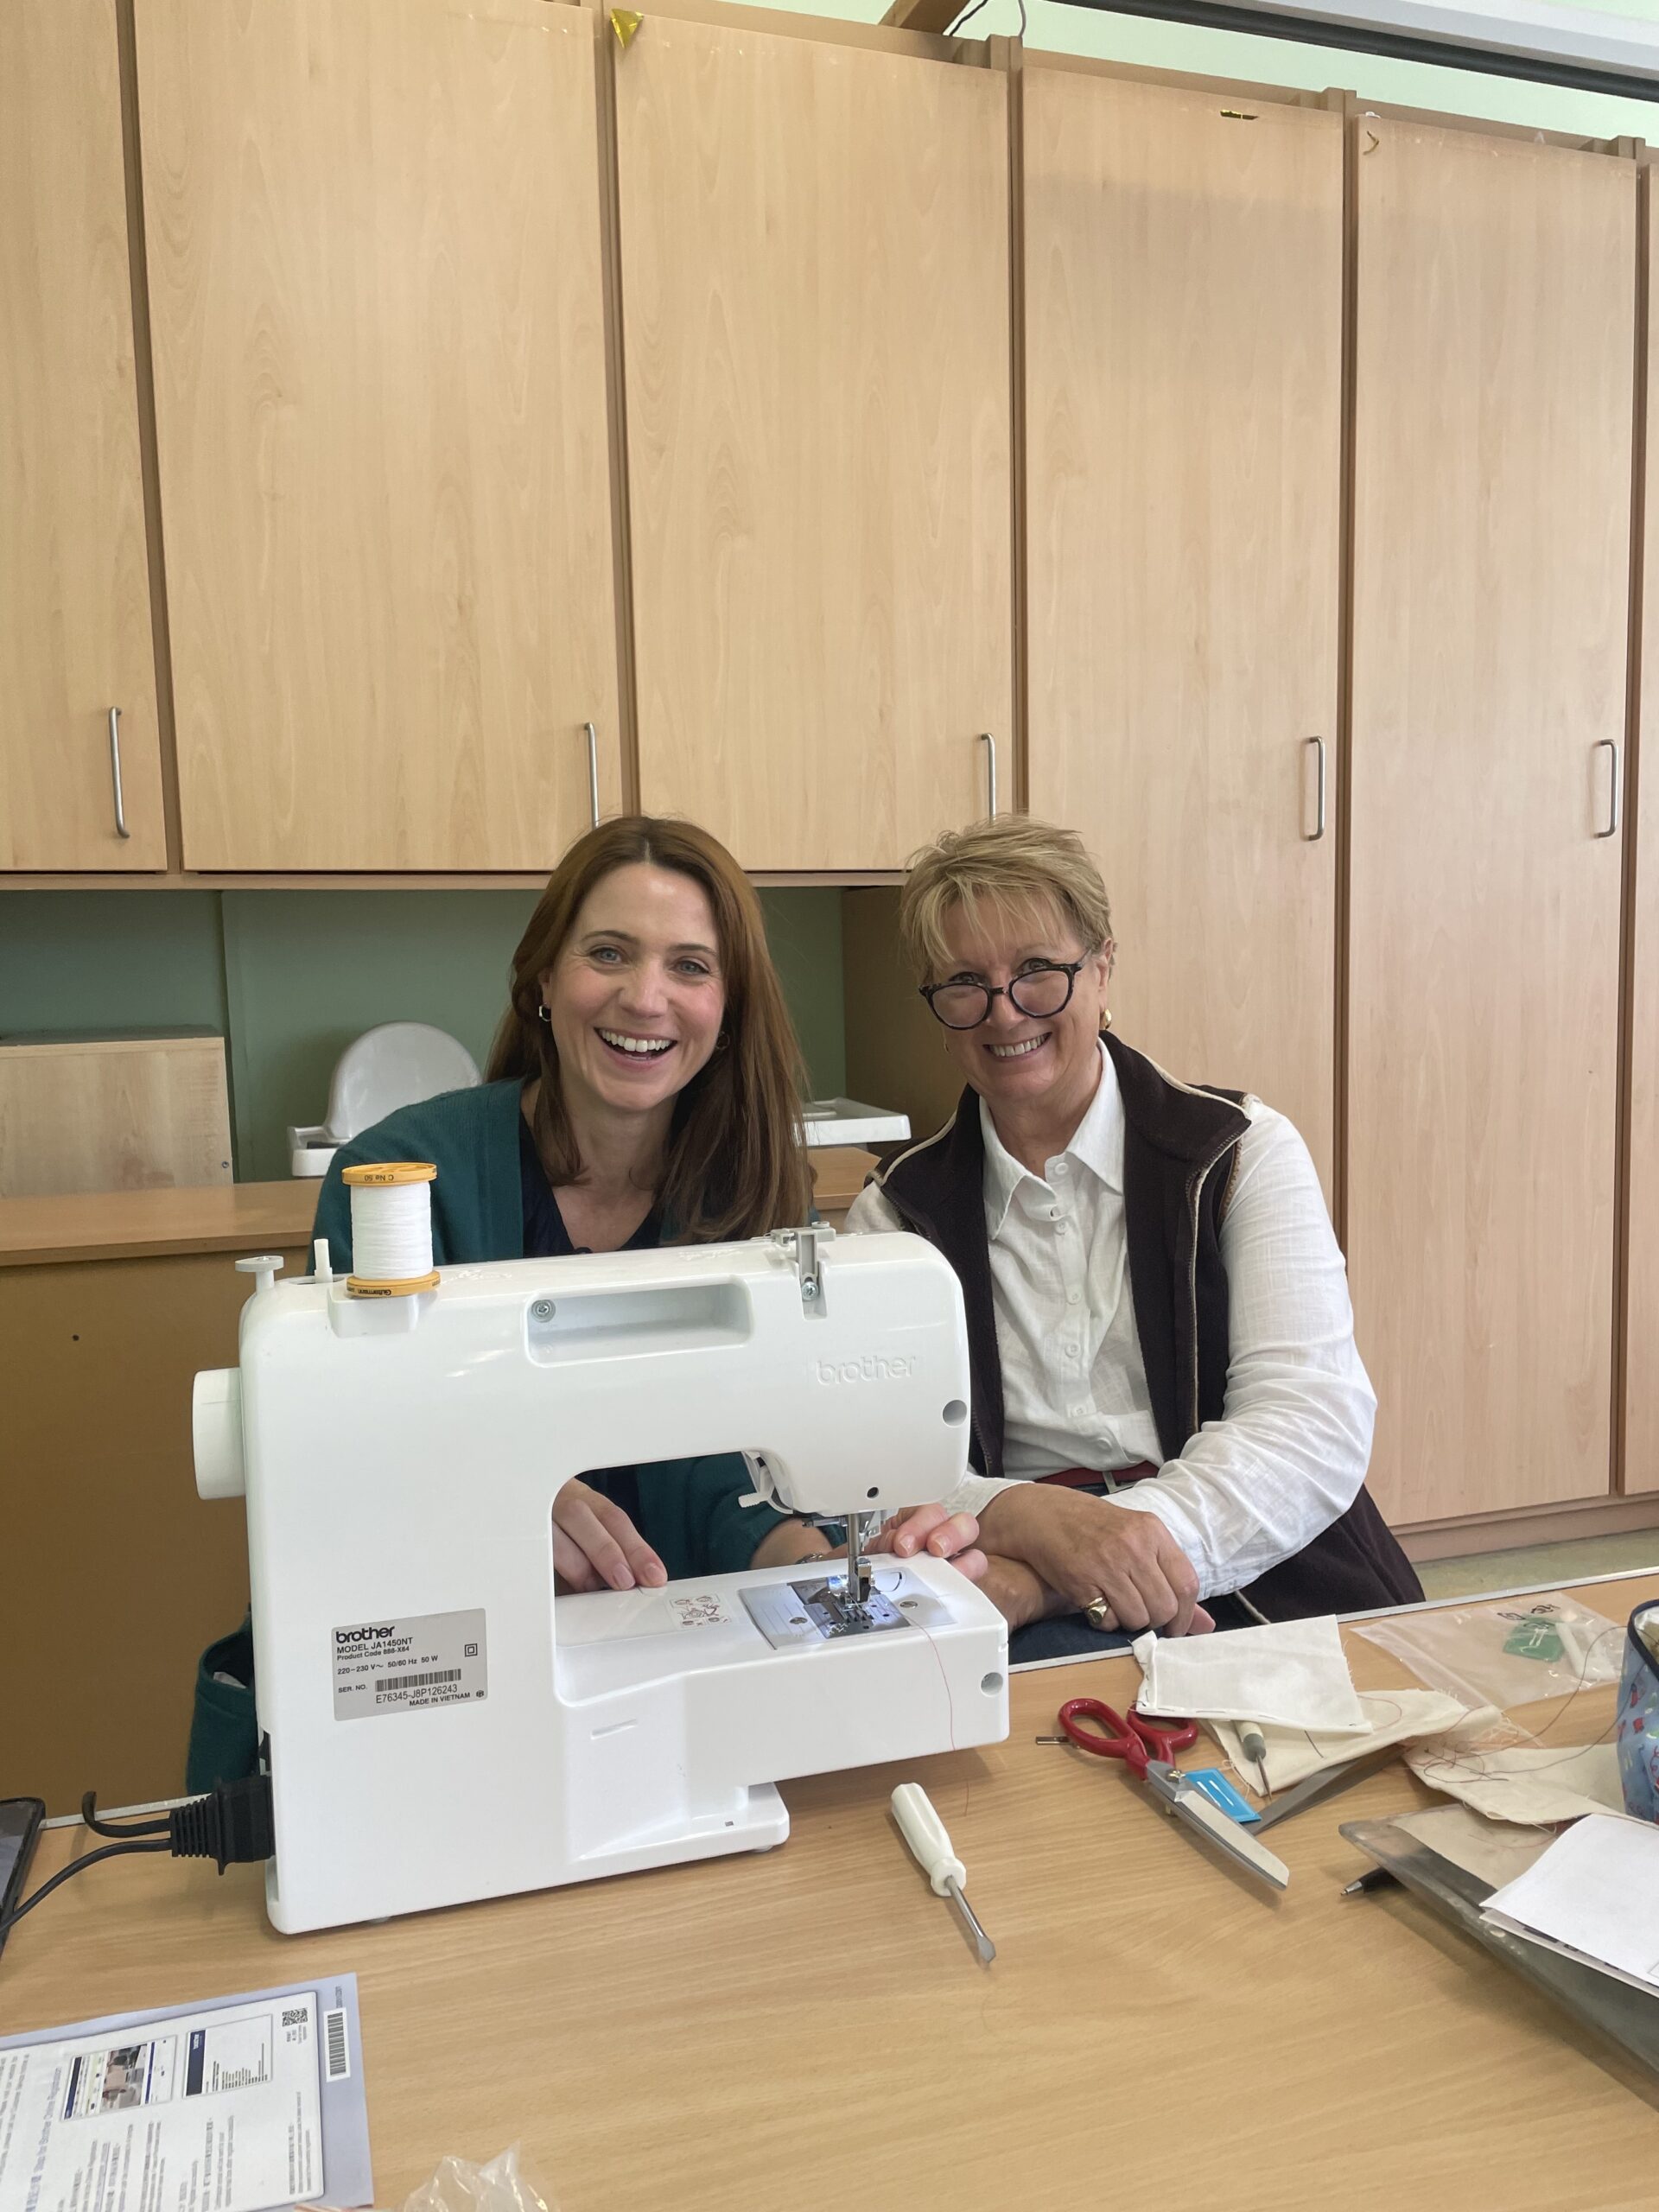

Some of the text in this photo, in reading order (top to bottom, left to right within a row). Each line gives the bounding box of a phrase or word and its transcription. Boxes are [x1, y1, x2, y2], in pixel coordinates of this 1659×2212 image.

[816, 1355, 916, 1386] brother
[336, 1626, 395, 1643] brother
[337, 1637, 413, 1654] MODEL JA1450NT
[337, 1652, 363, 1661] Product
[376, 1683, 458, 1704] E76345-J8P126243
[440, 1692, 471, 1702] VIETNAM
